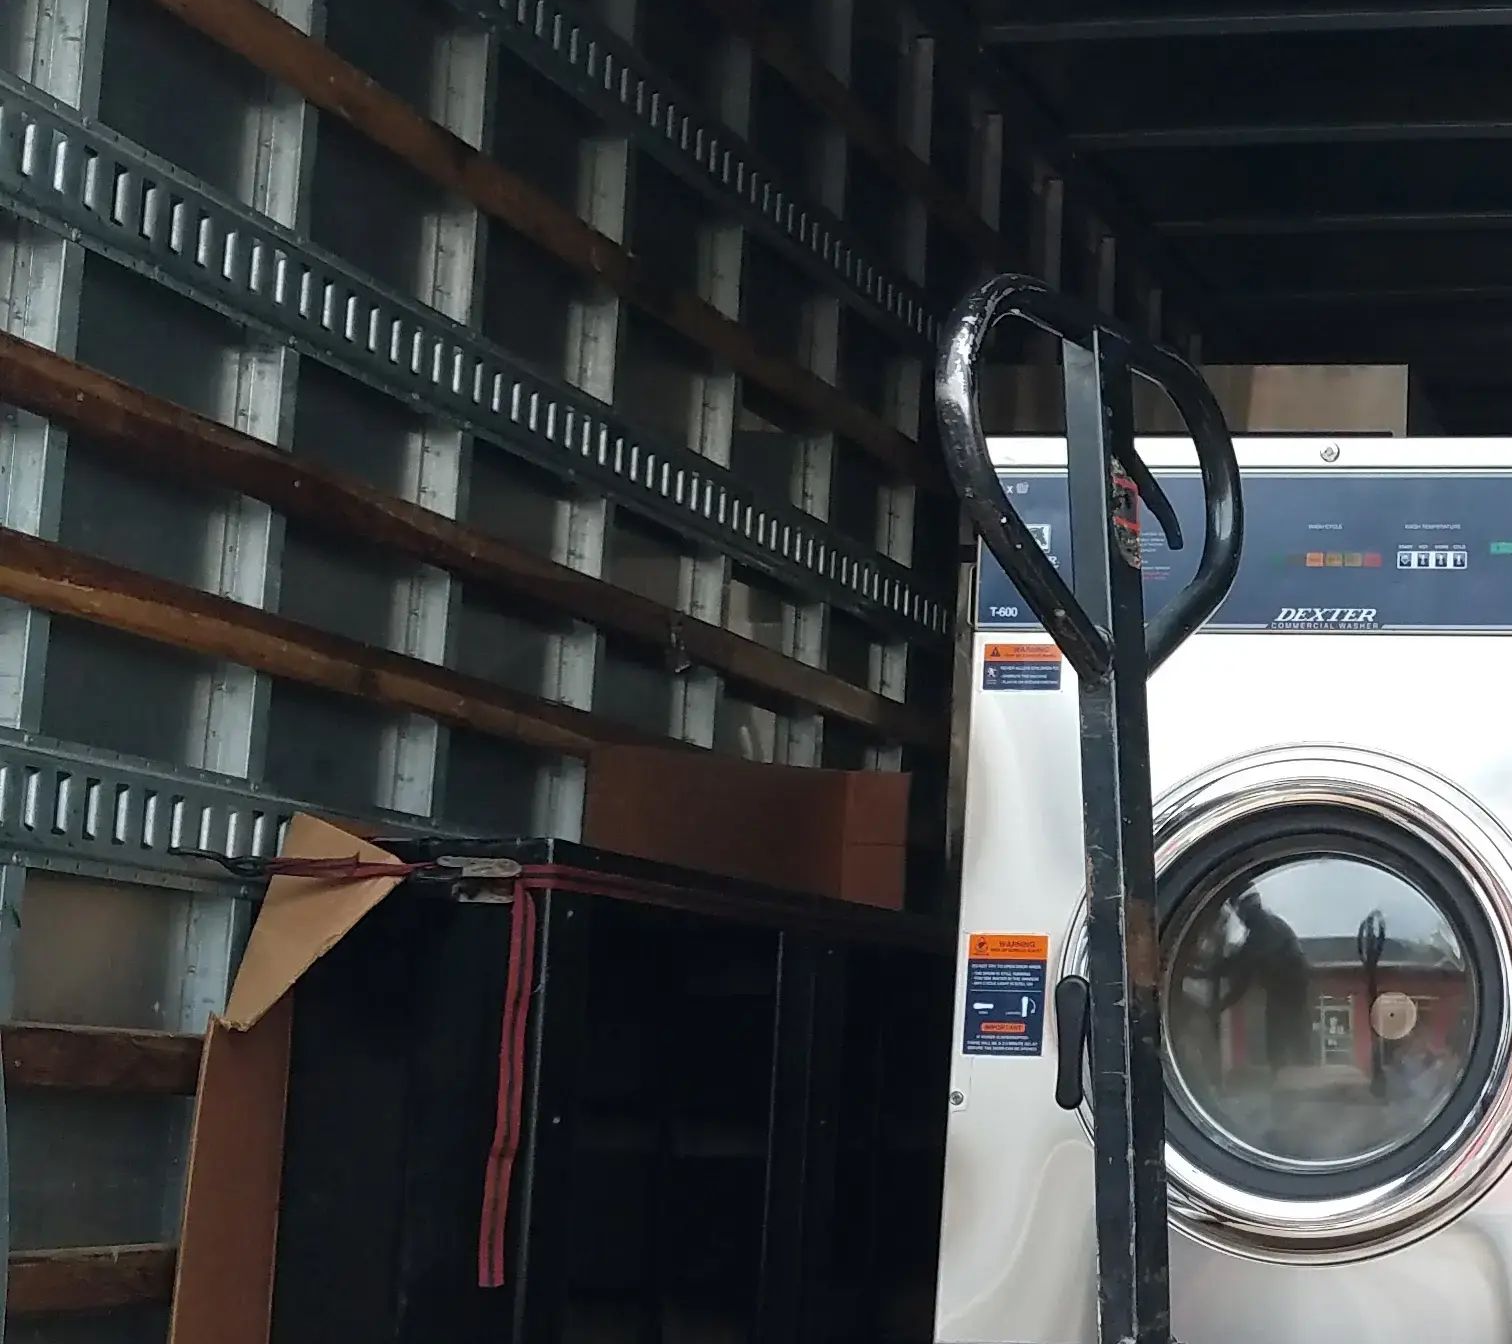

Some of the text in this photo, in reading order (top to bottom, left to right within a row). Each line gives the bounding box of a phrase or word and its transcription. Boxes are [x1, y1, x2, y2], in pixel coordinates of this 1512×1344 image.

[989, 606, 1018, 618] T-600
[1273, 607, 1378, 622] DEXTER
[1270, 622, 1380, 630] COMMERCIAL WASHER
